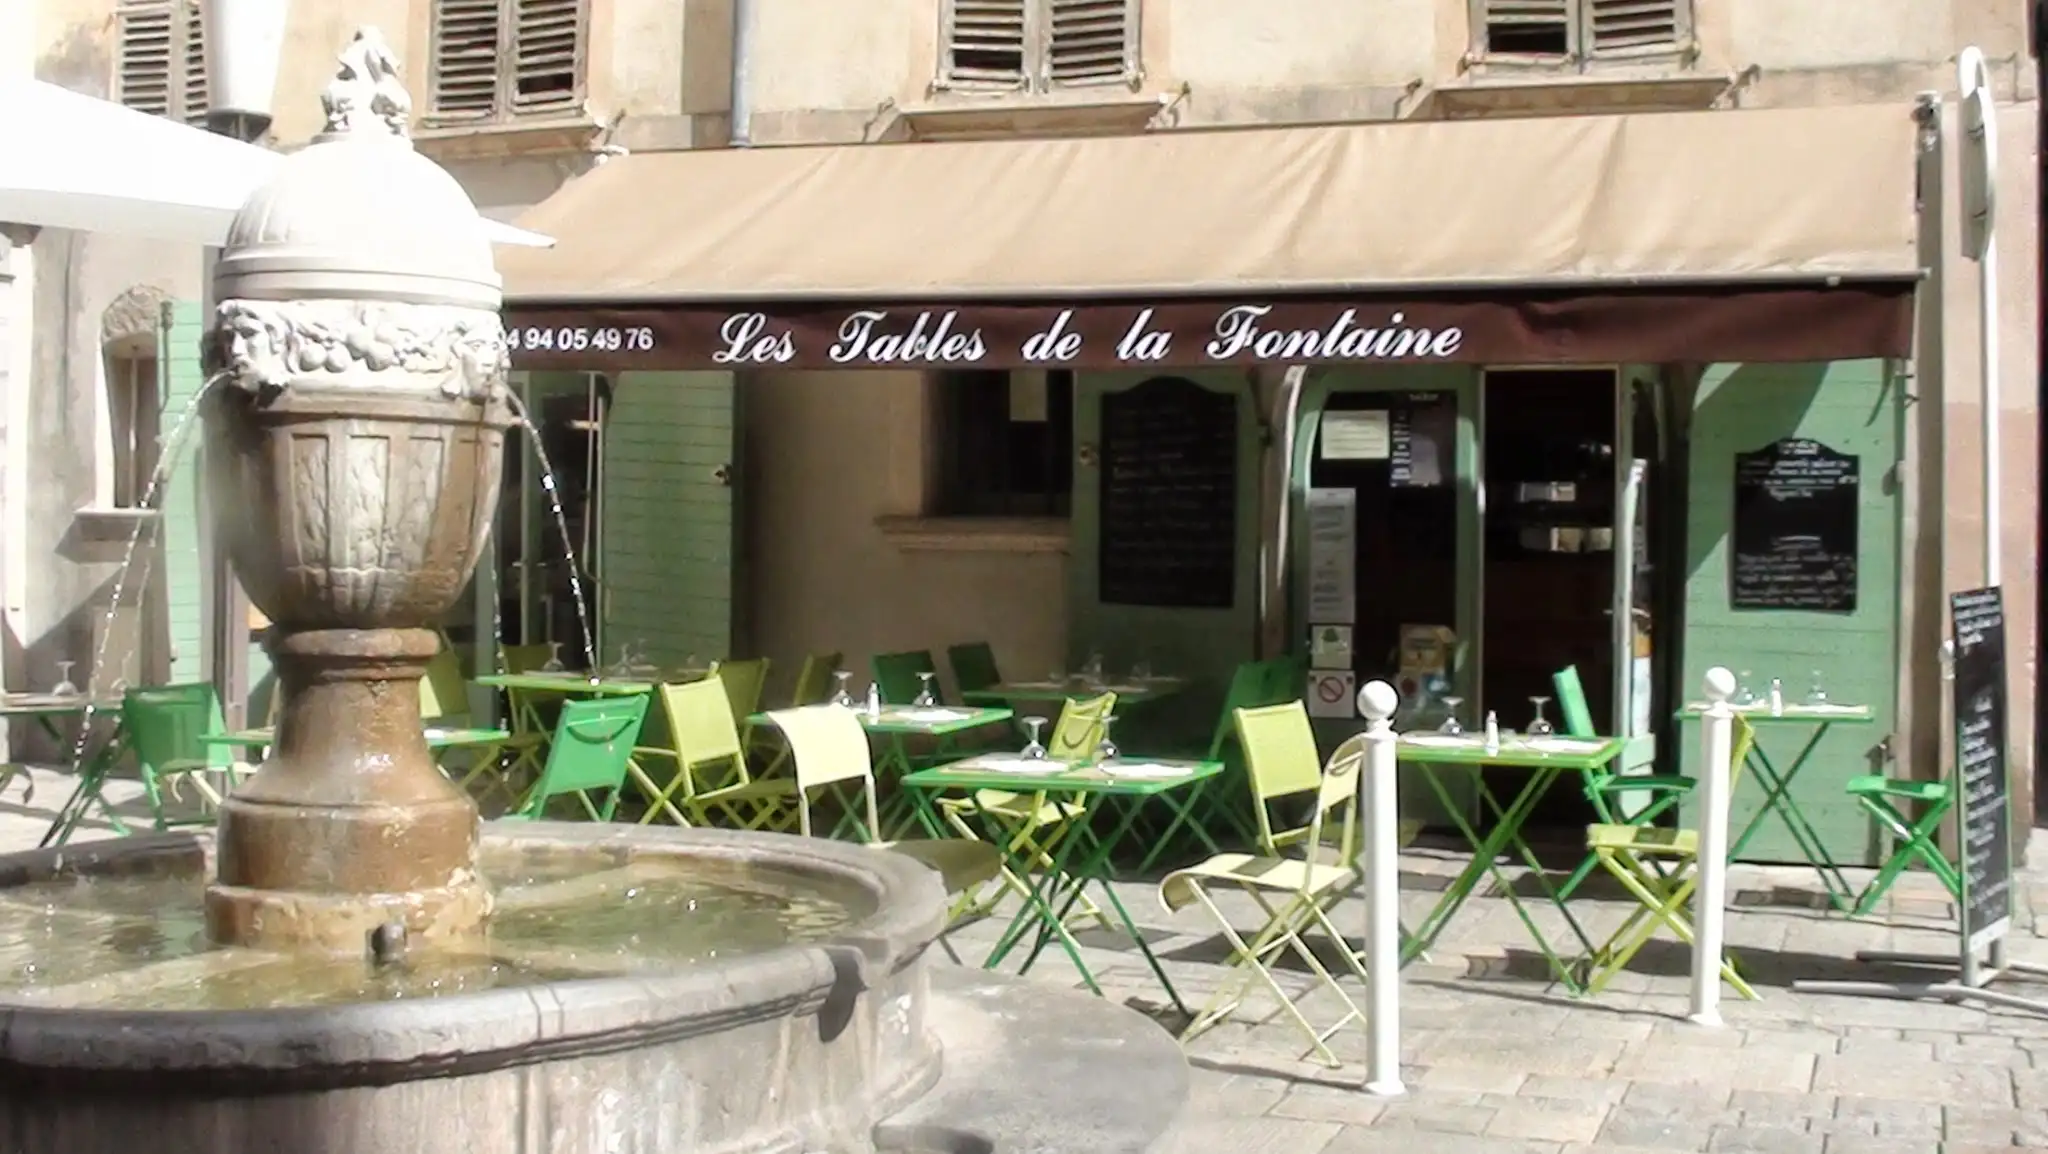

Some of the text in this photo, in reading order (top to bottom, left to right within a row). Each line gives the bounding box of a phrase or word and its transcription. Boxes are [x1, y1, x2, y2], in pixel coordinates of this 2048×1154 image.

[523, 326, 554, 351] 94
[556, 326, 589, 351] 05
[590, 326, 622, 351] 49
[624, 326, 655, 351] 76
[712, 304, 1462, 363] Les Tables de la Fontaine
